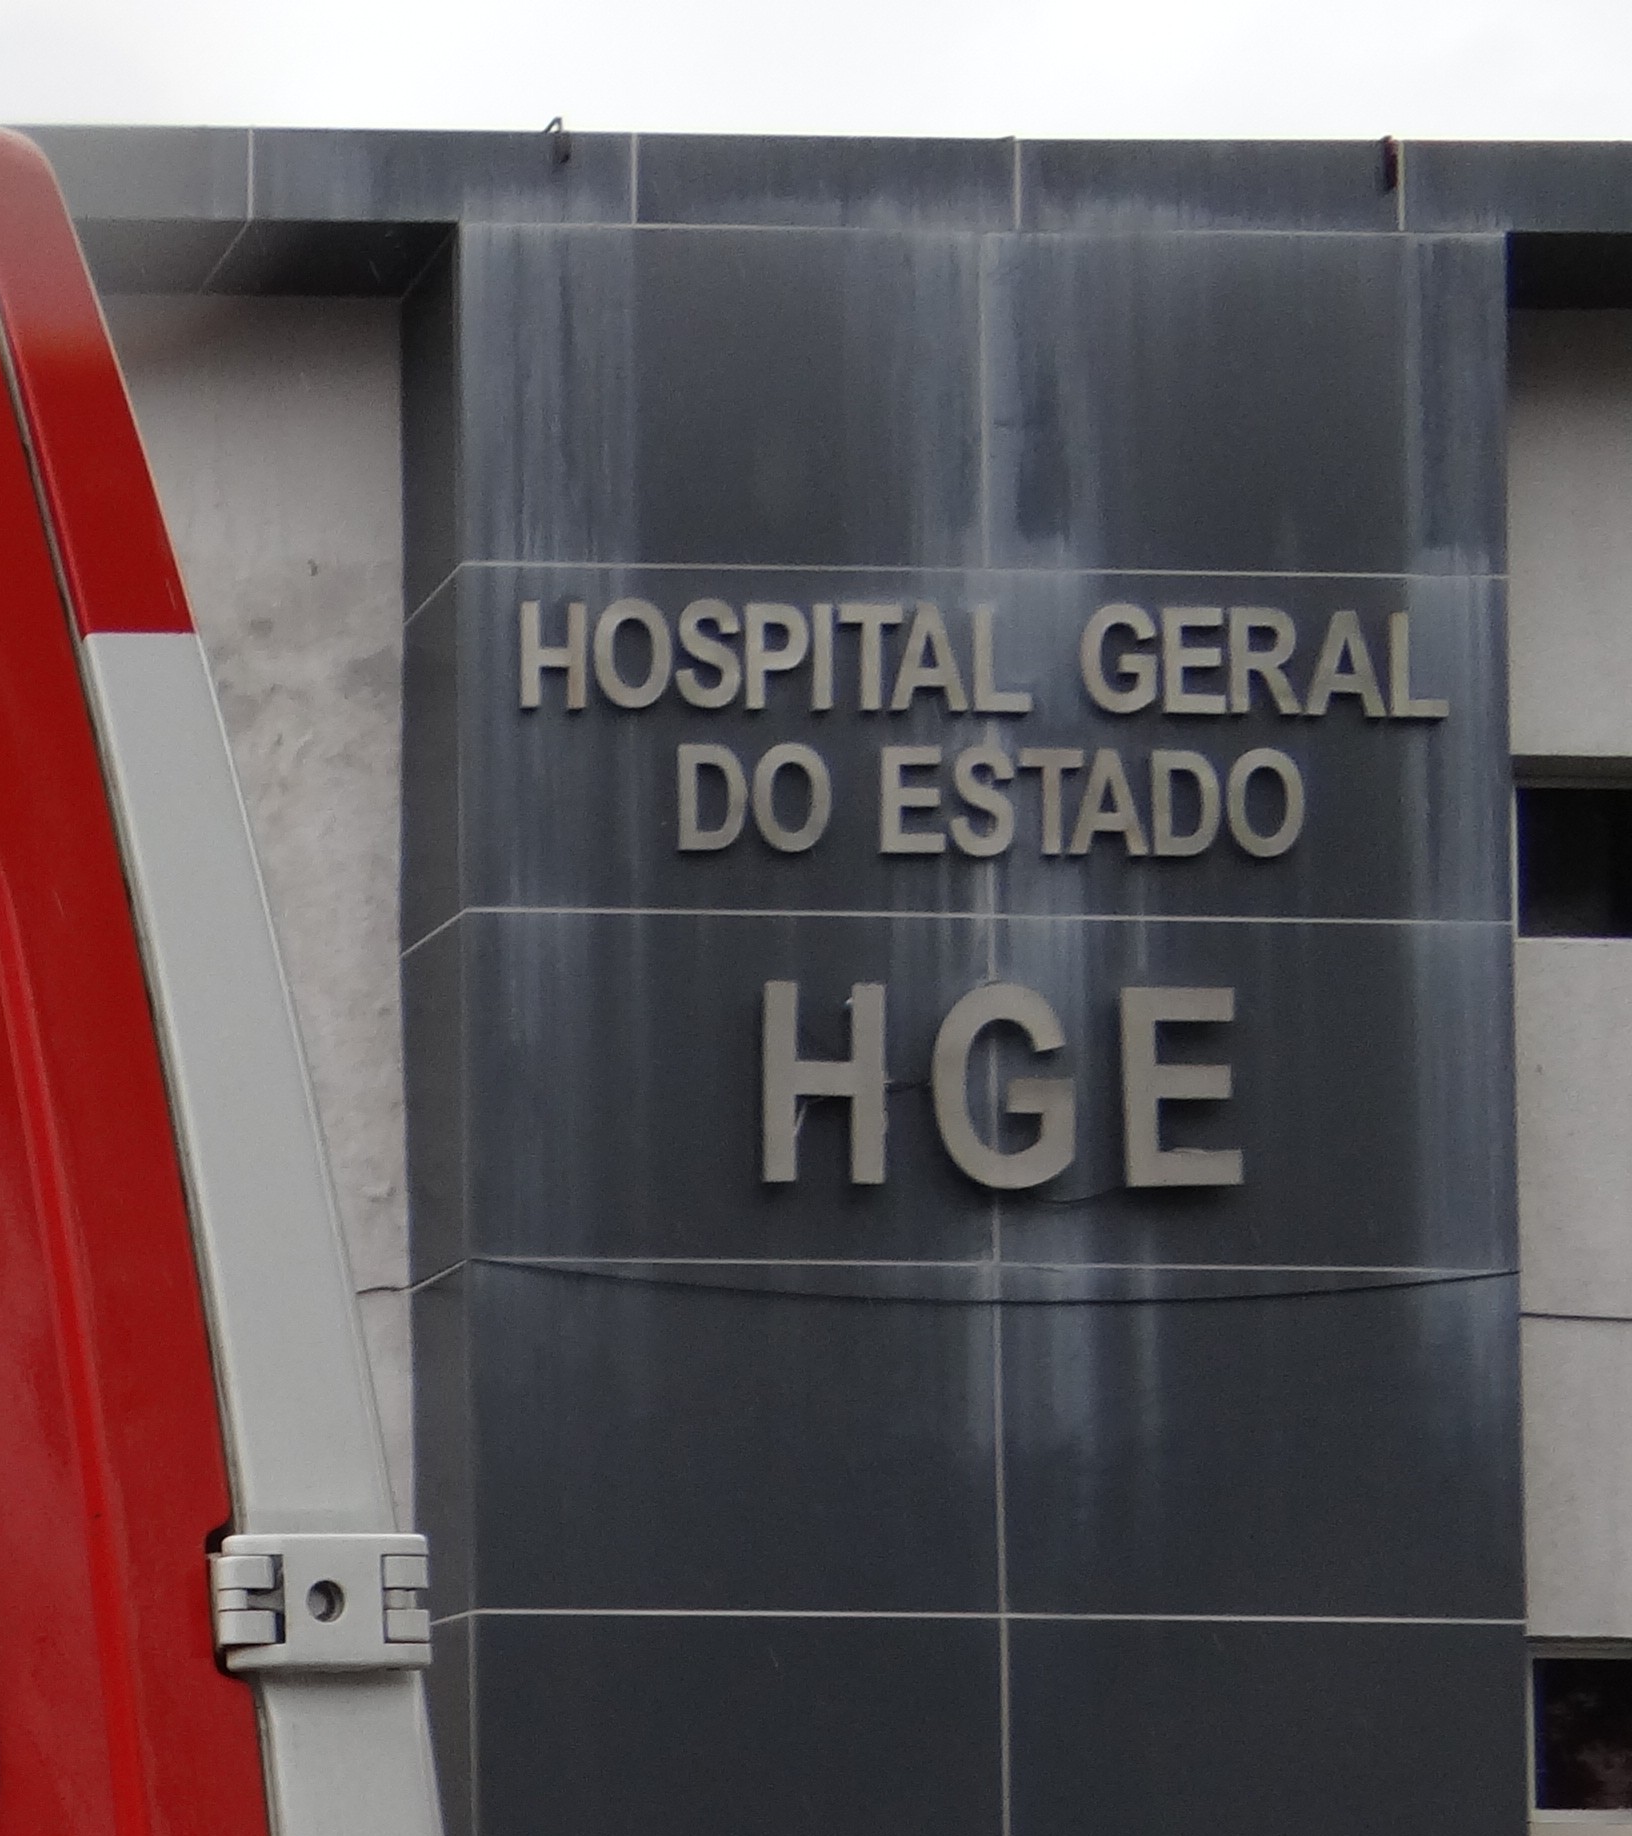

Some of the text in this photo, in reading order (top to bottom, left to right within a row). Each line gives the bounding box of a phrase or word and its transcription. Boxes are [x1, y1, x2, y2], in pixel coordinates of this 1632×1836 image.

[519, 598, 1450, 720] HOSPITAL GERAL
[675, 742, 1306, 859] DO ESTADO
[761, 980, 1245, 1190] HGE
